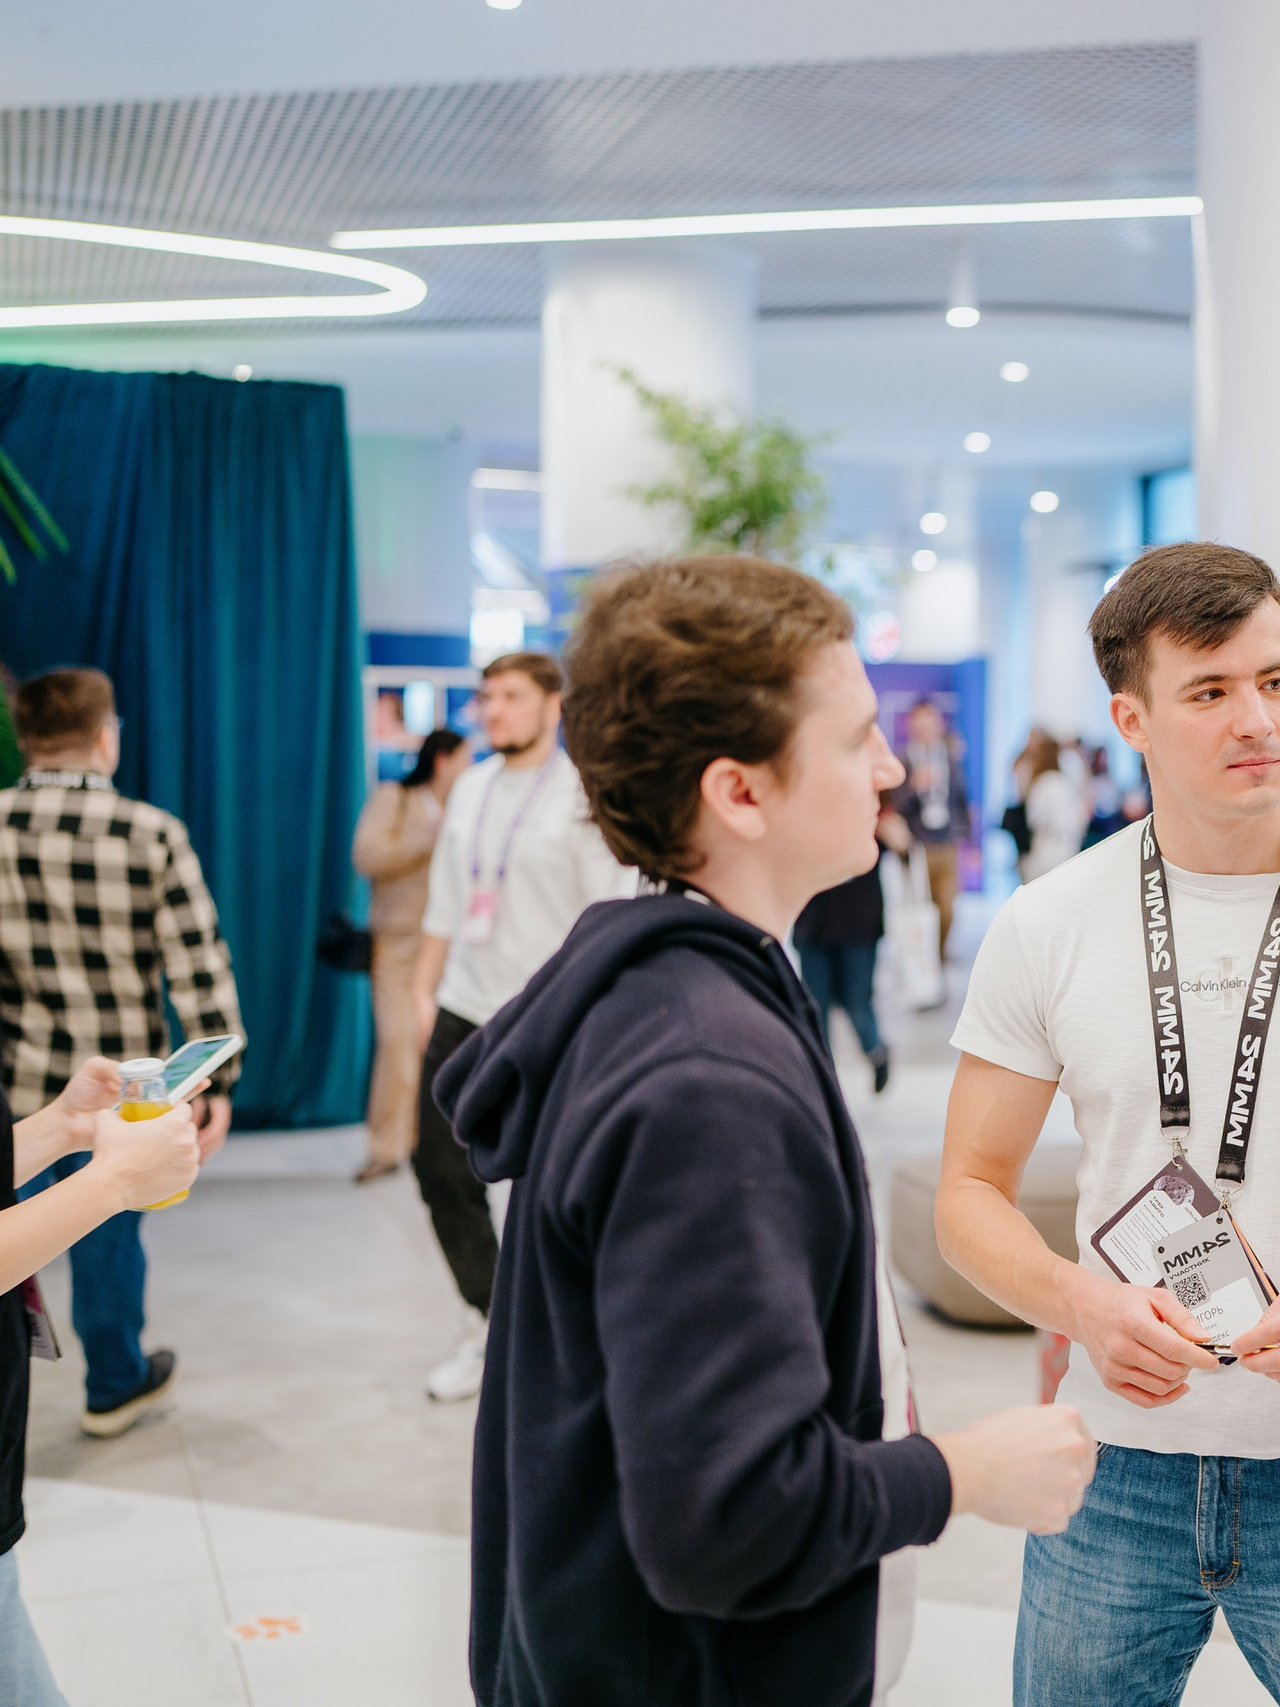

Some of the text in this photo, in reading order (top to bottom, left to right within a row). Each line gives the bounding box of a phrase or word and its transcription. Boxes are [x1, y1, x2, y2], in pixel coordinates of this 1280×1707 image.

[1180, 980, 1219, 992] Calvin
[1220, 977, 1247, 990] Klein
[1169, 1257, 1210, 1280] УЧАСТНИК
